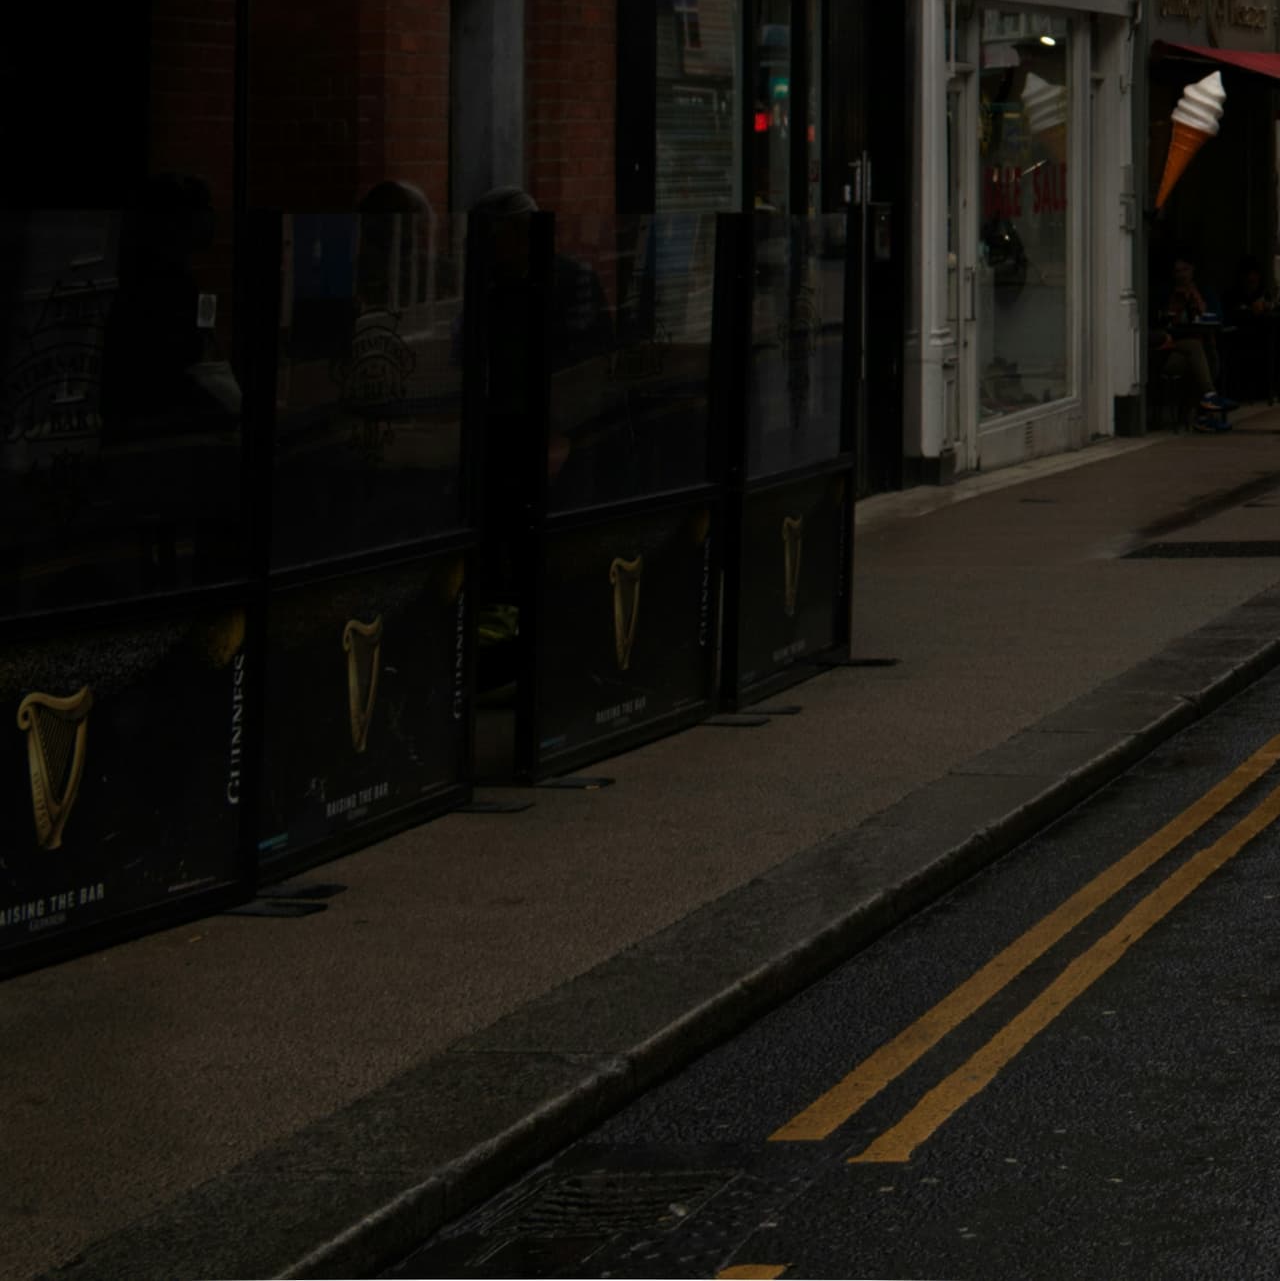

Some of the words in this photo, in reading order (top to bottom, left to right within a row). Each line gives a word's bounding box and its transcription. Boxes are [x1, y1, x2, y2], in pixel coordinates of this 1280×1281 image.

[226, 654, 249, 805] GUINNESS
[0, 899, 46, 927] AISING
[49, 889, 76, 913] THE
[79, 882, 105, 905] BAR
